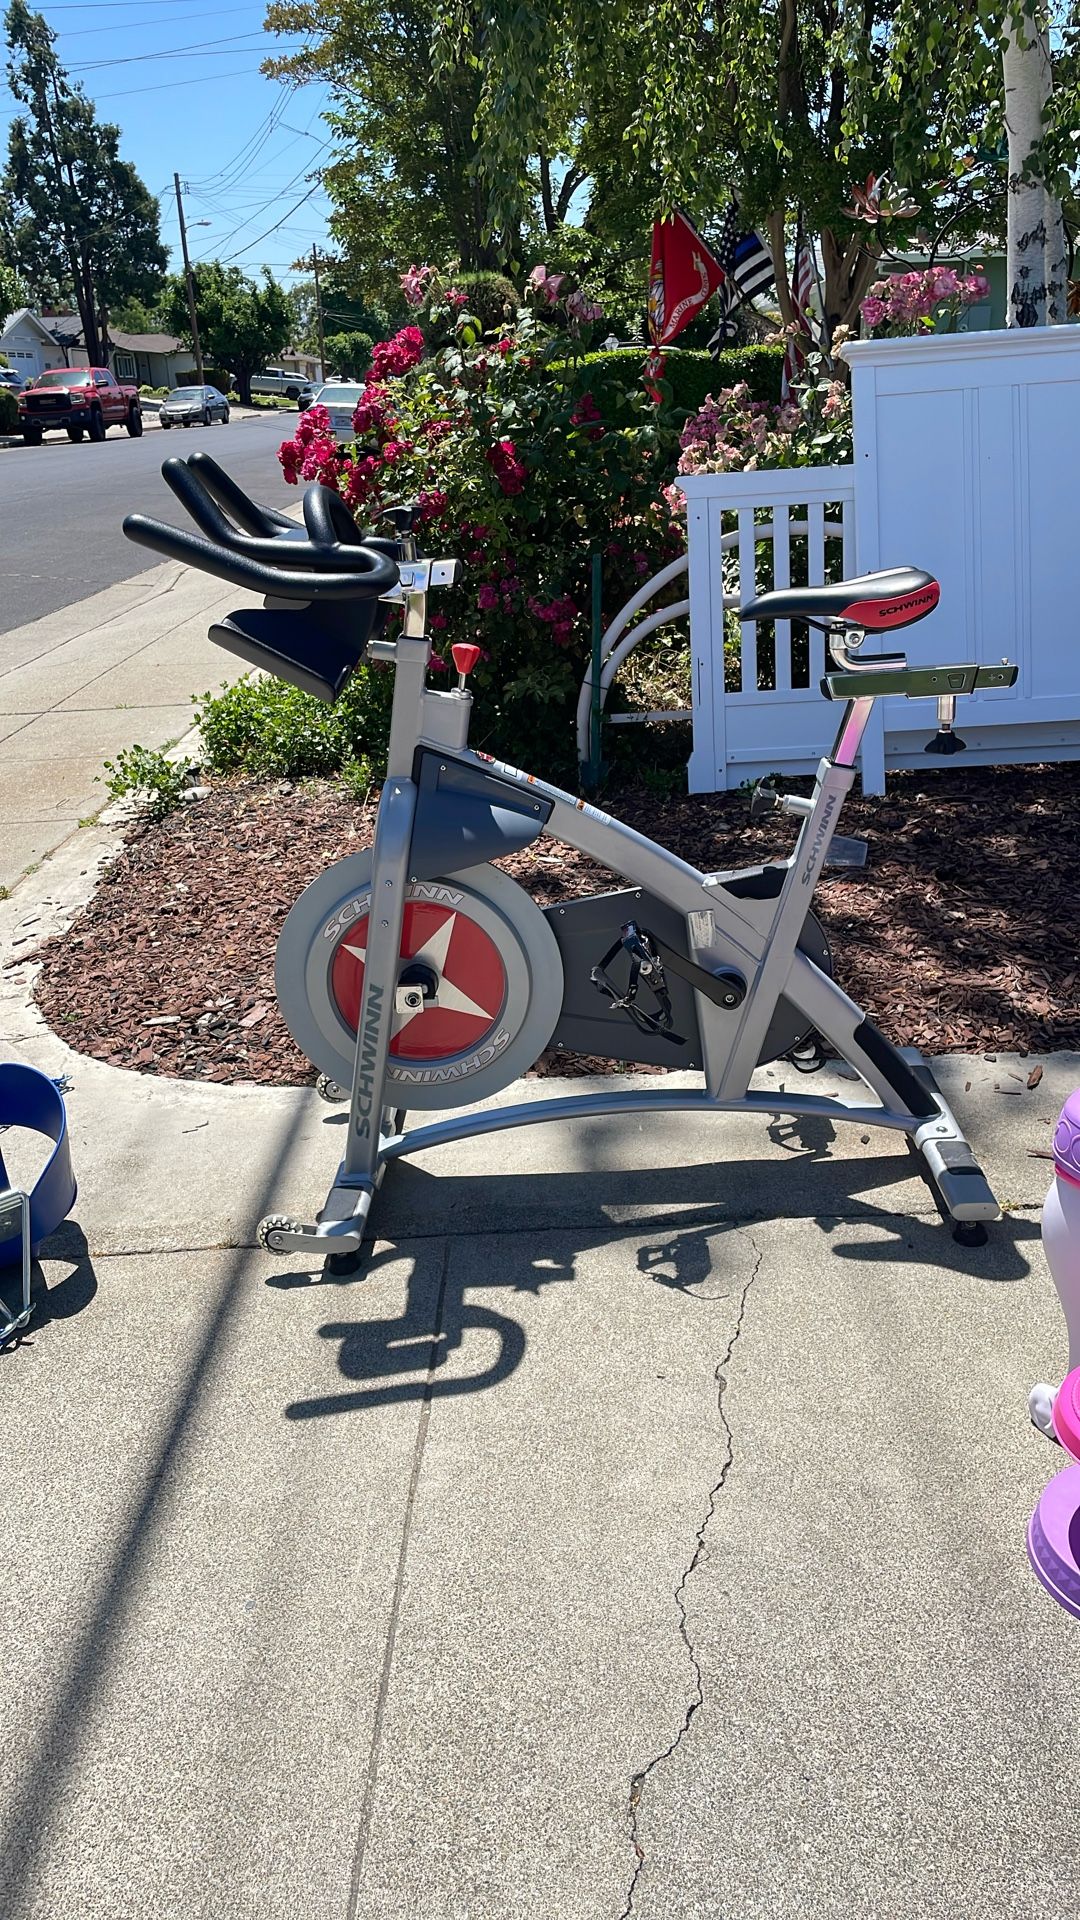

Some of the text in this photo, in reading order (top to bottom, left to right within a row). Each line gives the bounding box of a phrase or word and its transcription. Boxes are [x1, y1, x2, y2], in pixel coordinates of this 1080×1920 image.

[669, 298, 693, 328] MARINE
[879, 594, 933, 617] SCHWINN
[801, 794, 837, 887] SCHWINN
[323, 884, 465, 943] SCHINN
[355, 983, 384, 1139] SCHWINN
